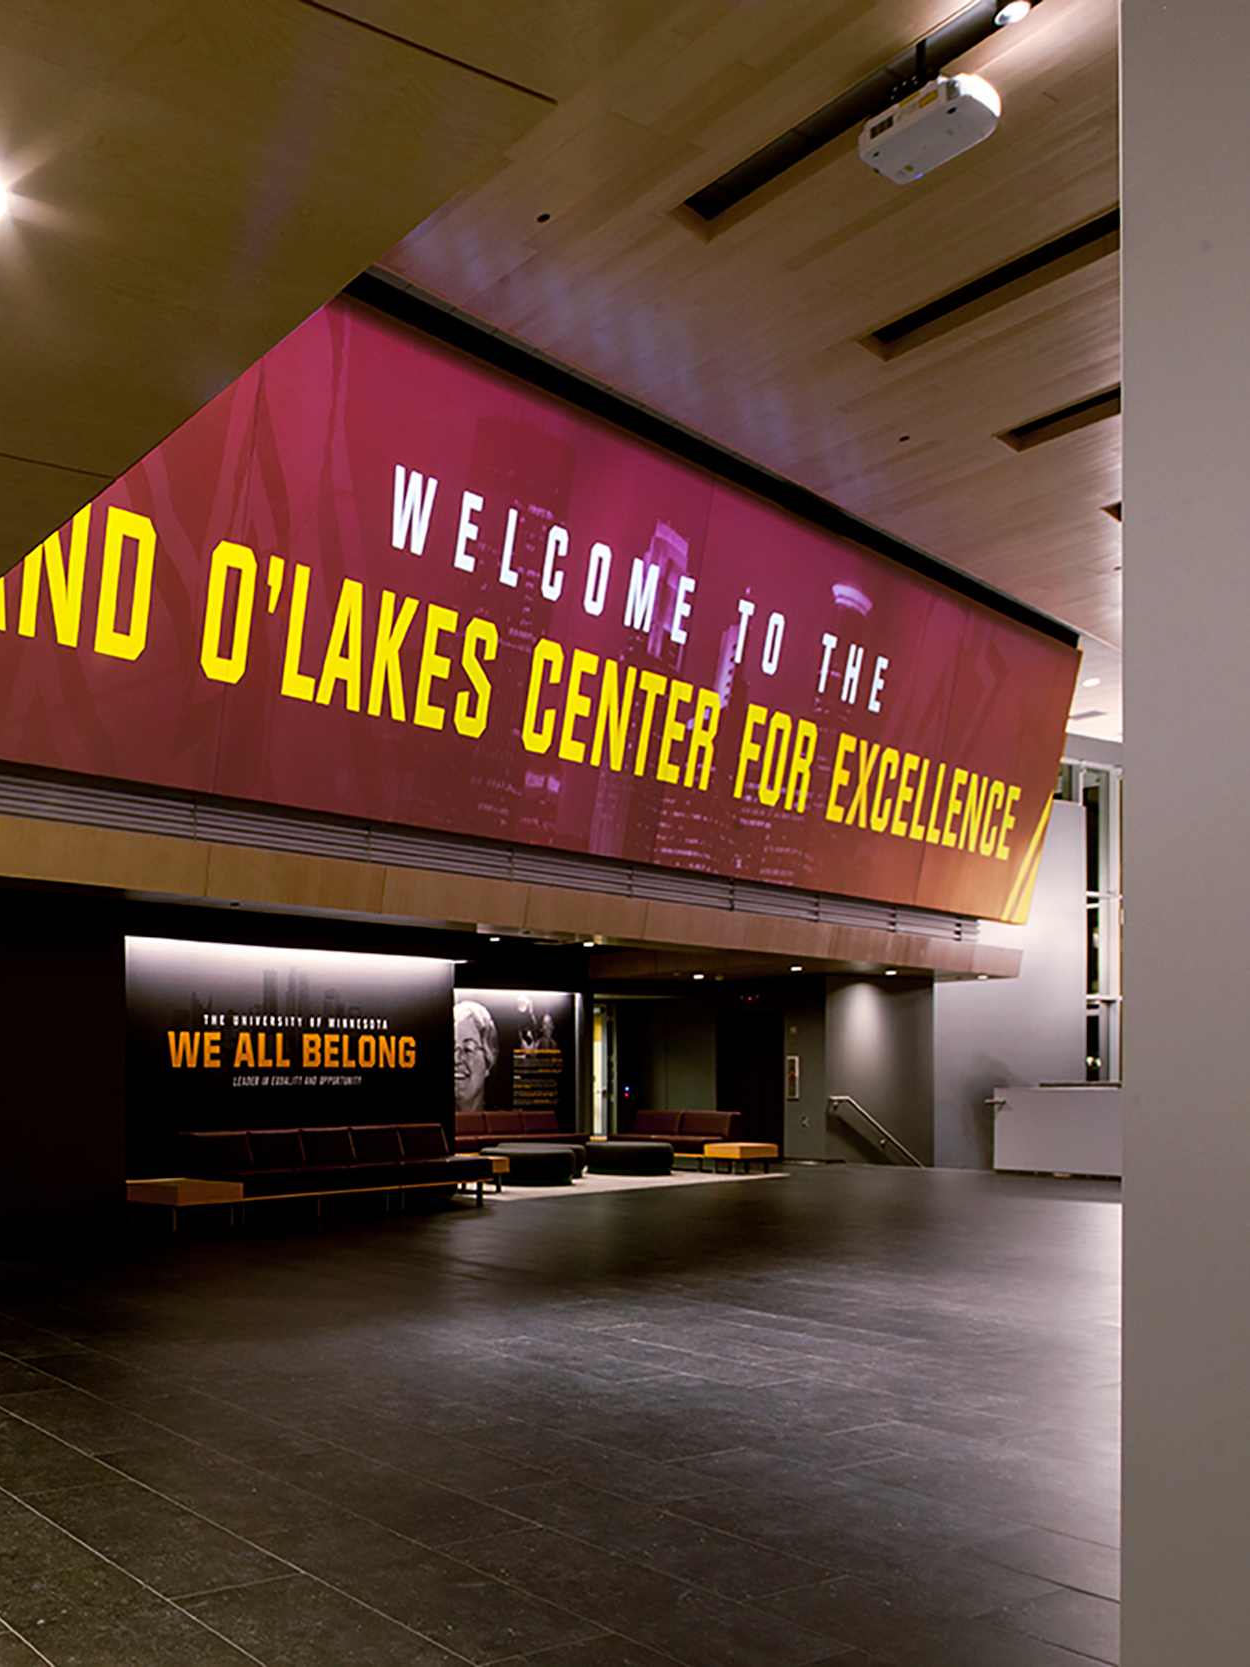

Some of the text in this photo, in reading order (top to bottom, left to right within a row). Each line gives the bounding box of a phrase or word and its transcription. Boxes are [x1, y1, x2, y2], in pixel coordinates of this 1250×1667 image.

[392, 464, 889, 714] WELCOME TO THE
[201, 540, 499, 739] O'LAKES
[522, 638, 722, 791] CENTER
[733, 703, 818, 814] FOR
[826, 732, 1022, 861] EXCELLENCE
[167, 1030, 417, 1069] WE ALL BELONG
[203, 1014, 388, 1030] THE UNIVERSITY OF MINNESOTA
